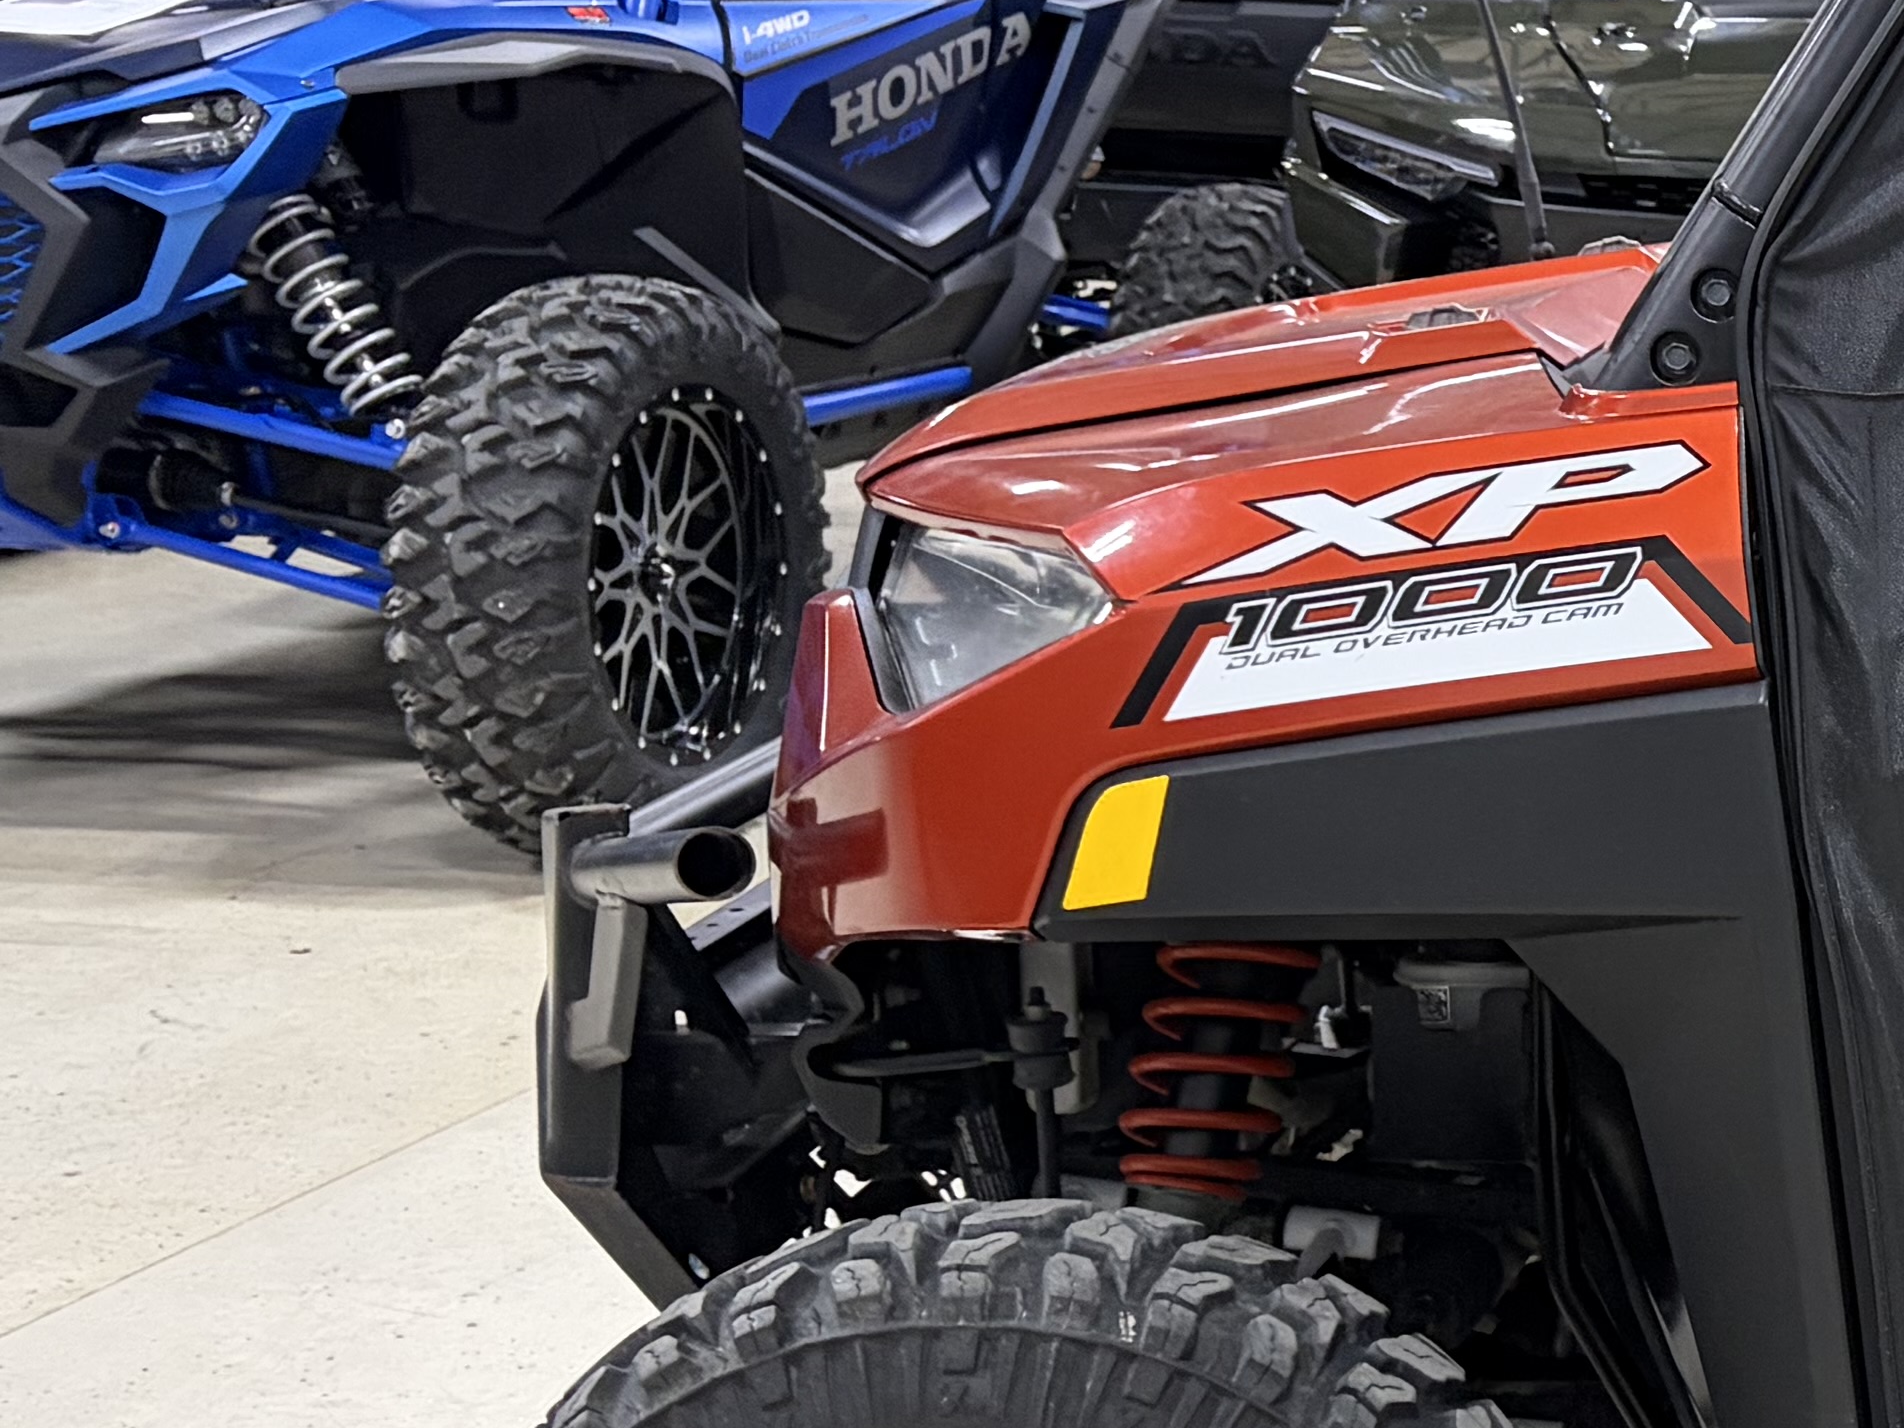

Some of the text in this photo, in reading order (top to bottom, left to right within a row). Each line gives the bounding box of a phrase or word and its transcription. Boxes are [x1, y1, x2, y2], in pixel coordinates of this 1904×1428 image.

[829, 11, 1032, 147] HONDA
[1160, 439, 1712, 590] XP
[1219, 545, 1645, 656] 1000
[1225, 602, 1625, 670] DUAL OVERHEAD CAM
